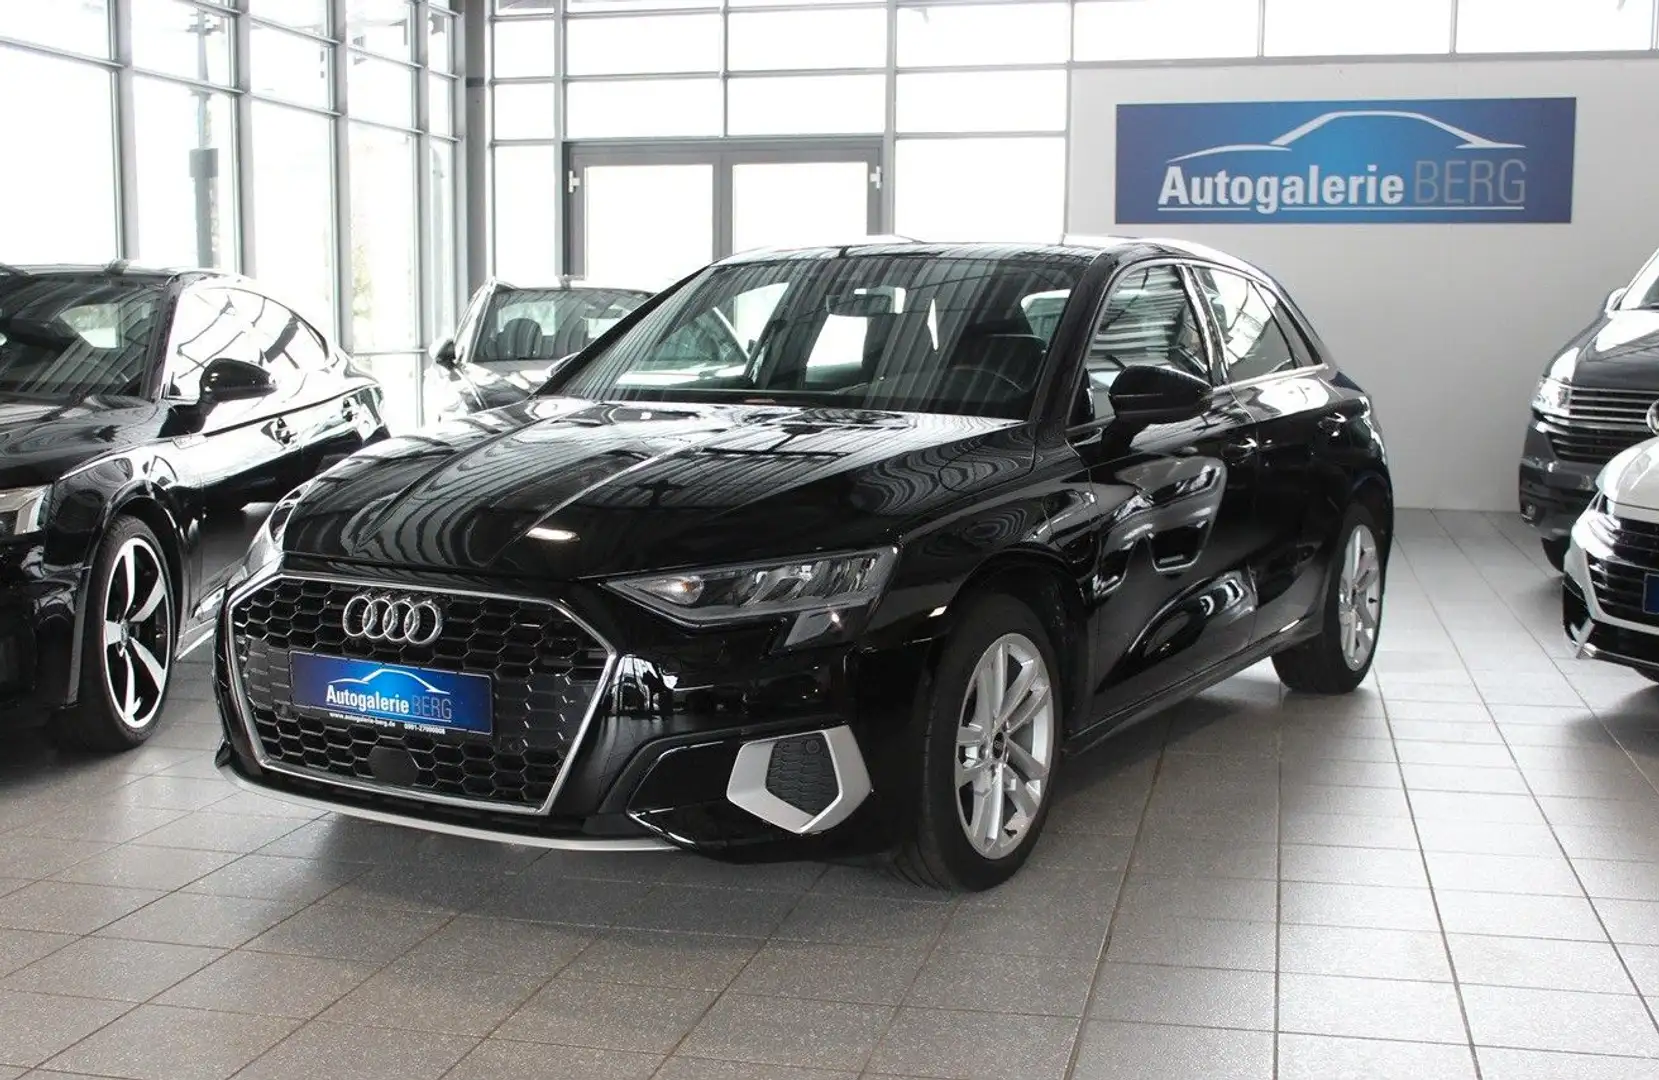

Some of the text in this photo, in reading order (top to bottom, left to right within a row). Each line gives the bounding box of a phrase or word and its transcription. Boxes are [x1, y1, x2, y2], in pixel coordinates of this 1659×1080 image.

[1158, 159, 1526, 214] Autogalerie BERG
[326, 684, 452, 720] Autogalerie BERG
